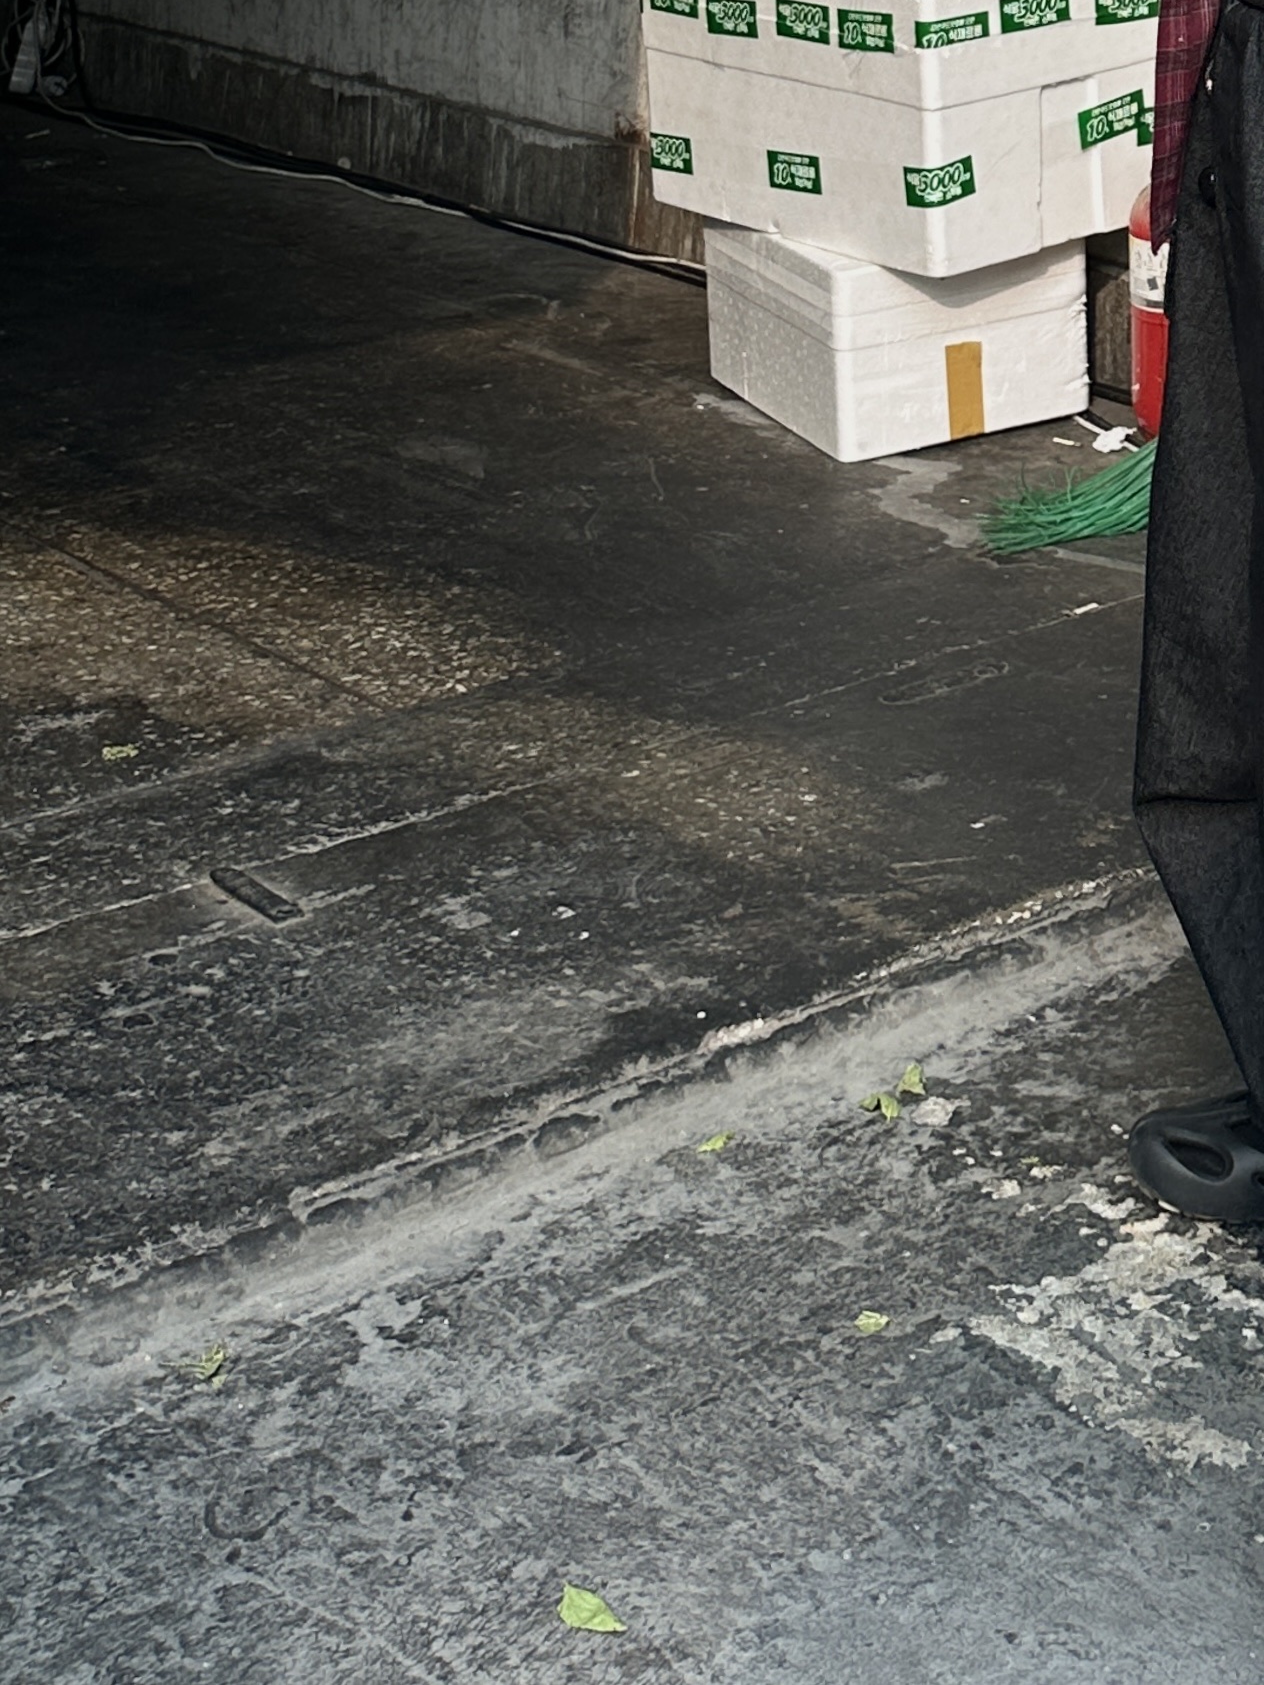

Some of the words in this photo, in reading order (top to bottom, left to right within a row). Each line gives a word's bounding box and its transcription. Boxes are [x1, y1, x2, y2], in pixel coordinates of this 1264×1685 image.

[715, 0, 750, 24] 3000
[786, 3, 823, 29] 3000
[1086, 115, 1108, 142] 10
[653, 136, 686, 159] 3000
[915, 162, 964, 196] 3000
